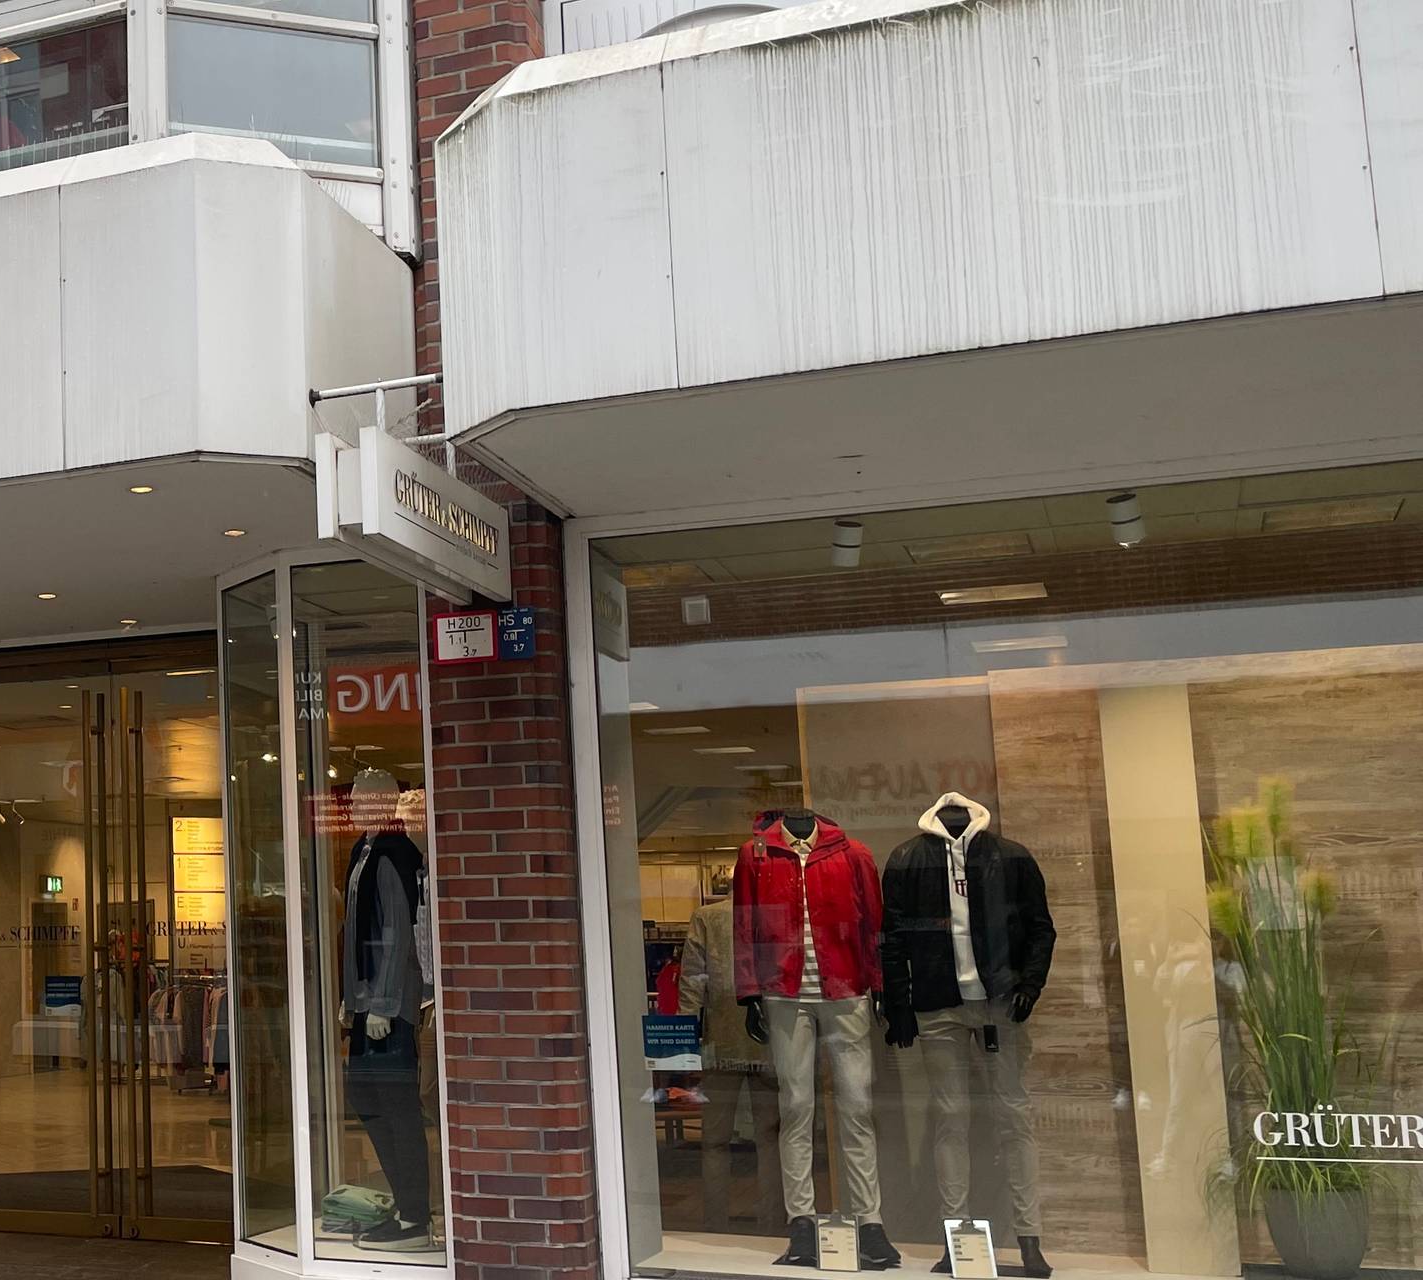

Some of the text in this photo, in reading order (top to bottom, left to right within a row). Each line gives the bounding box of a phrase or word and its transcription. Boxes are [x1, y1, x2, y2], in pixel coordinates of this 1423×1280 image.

[395, 468, 441, 526] GRÜTER
[448, 502, 499, 557] SCHIMPFF
[498, 614, 533, 627] HS 80
[1253, 1104, 1423, 1149] GRÜTER
